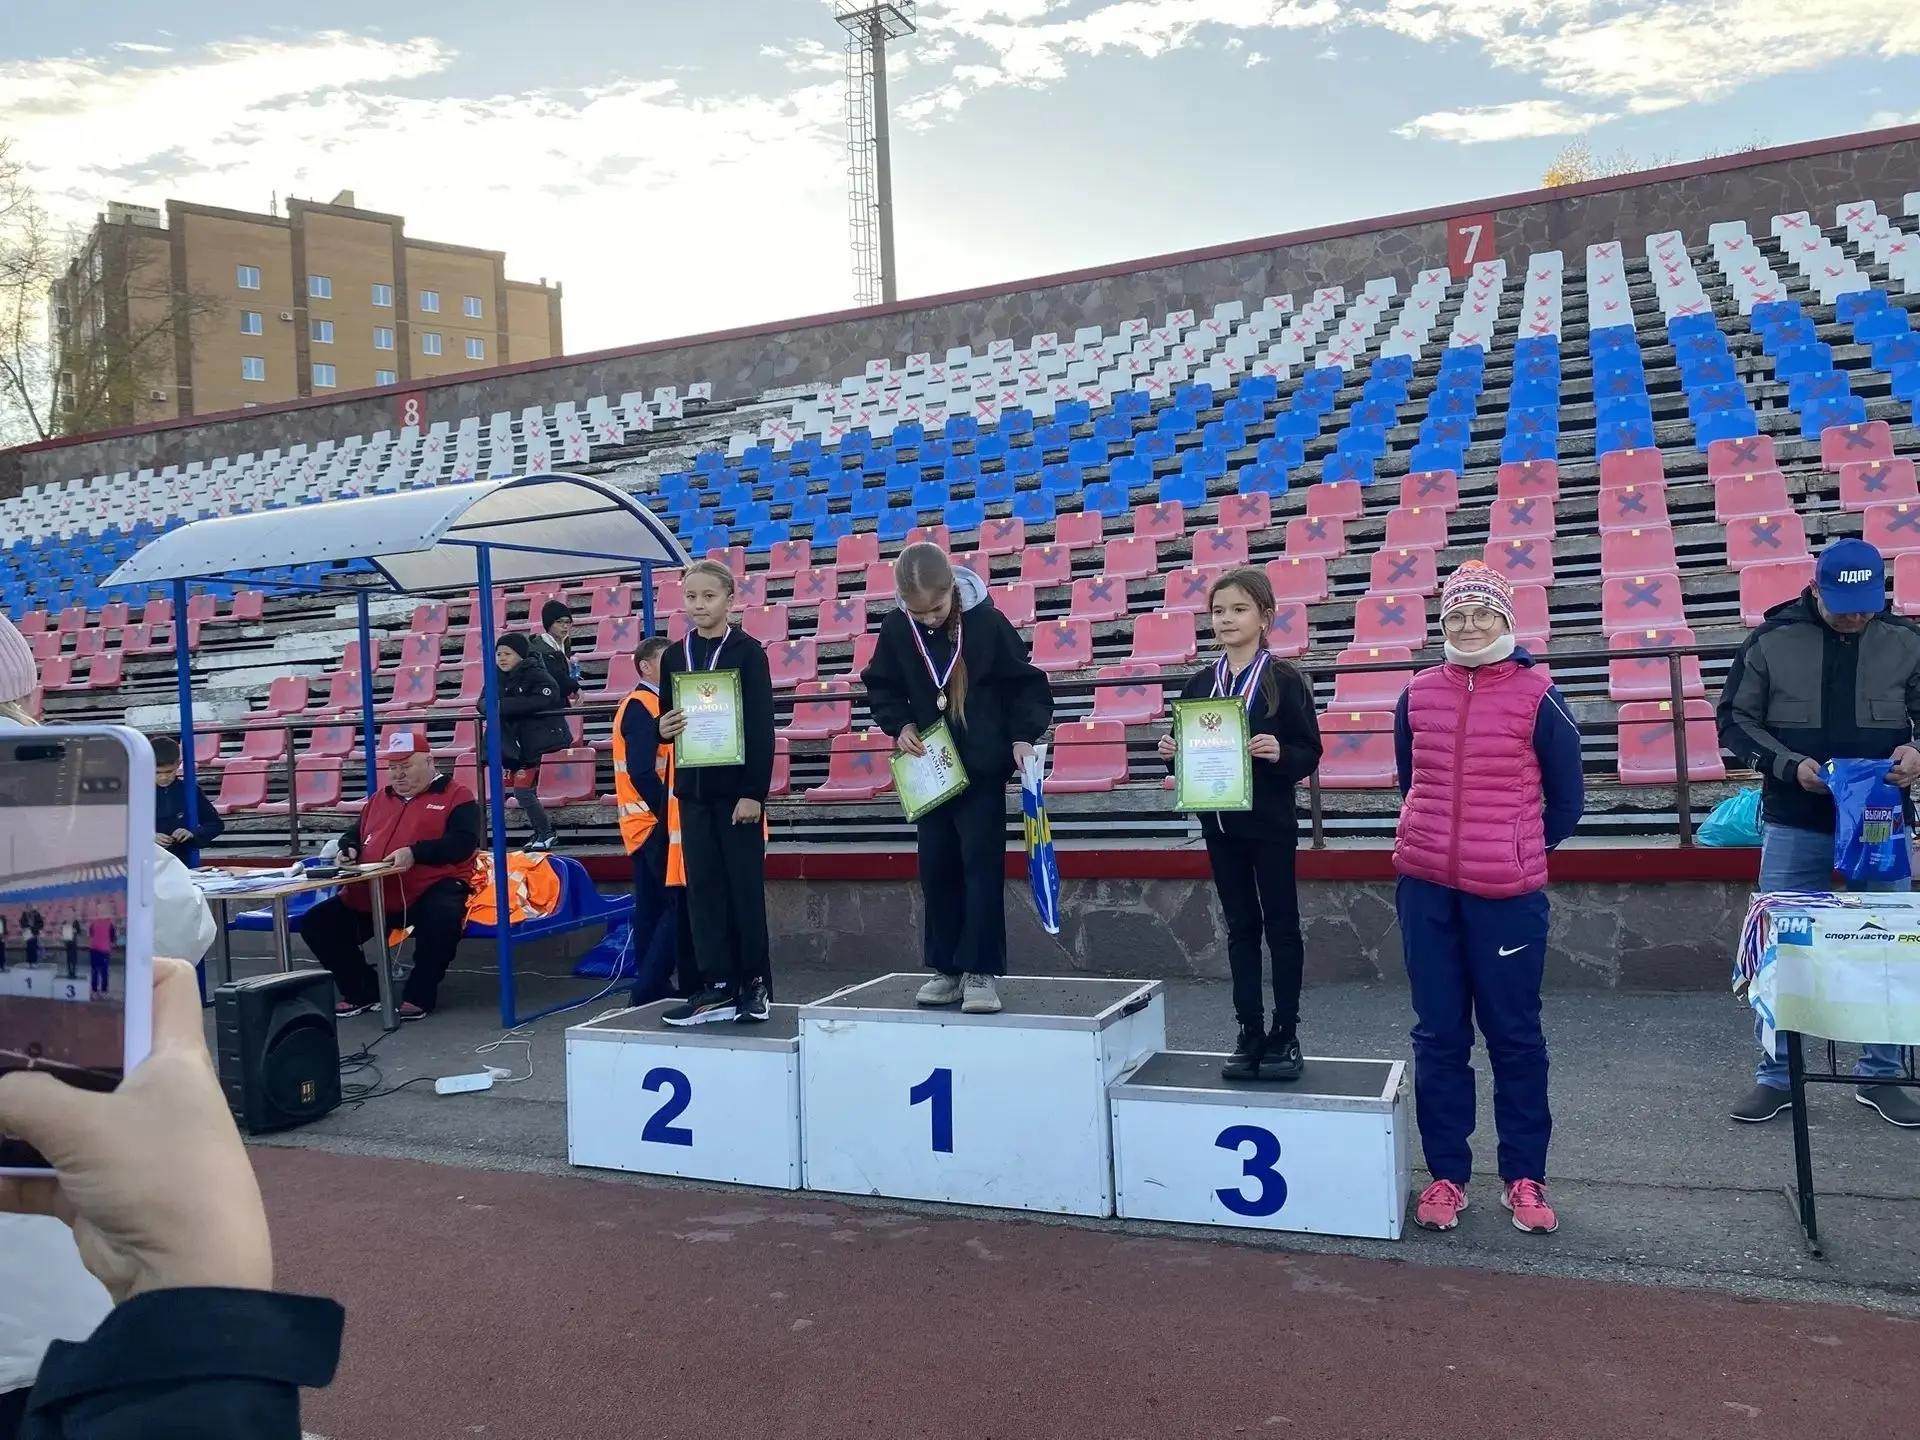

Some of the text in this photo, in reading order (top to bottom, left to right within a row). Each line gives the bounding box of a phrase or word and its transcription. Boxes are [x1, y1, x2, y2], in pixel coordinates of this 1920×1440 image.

[1459, 225, 1482, 264] 7
[404, 399, 419, 426] 8
[1838, 569, 1872, 584] ЛДПР
[926, 744, 947, 786] ГРАМОТА
[65, 984, 76, 998] 3
[641, 1067, 693, 1147] 2
[909, 1067, 954, 1154] 1
[1214, 1124, 1288, 1218] 3
